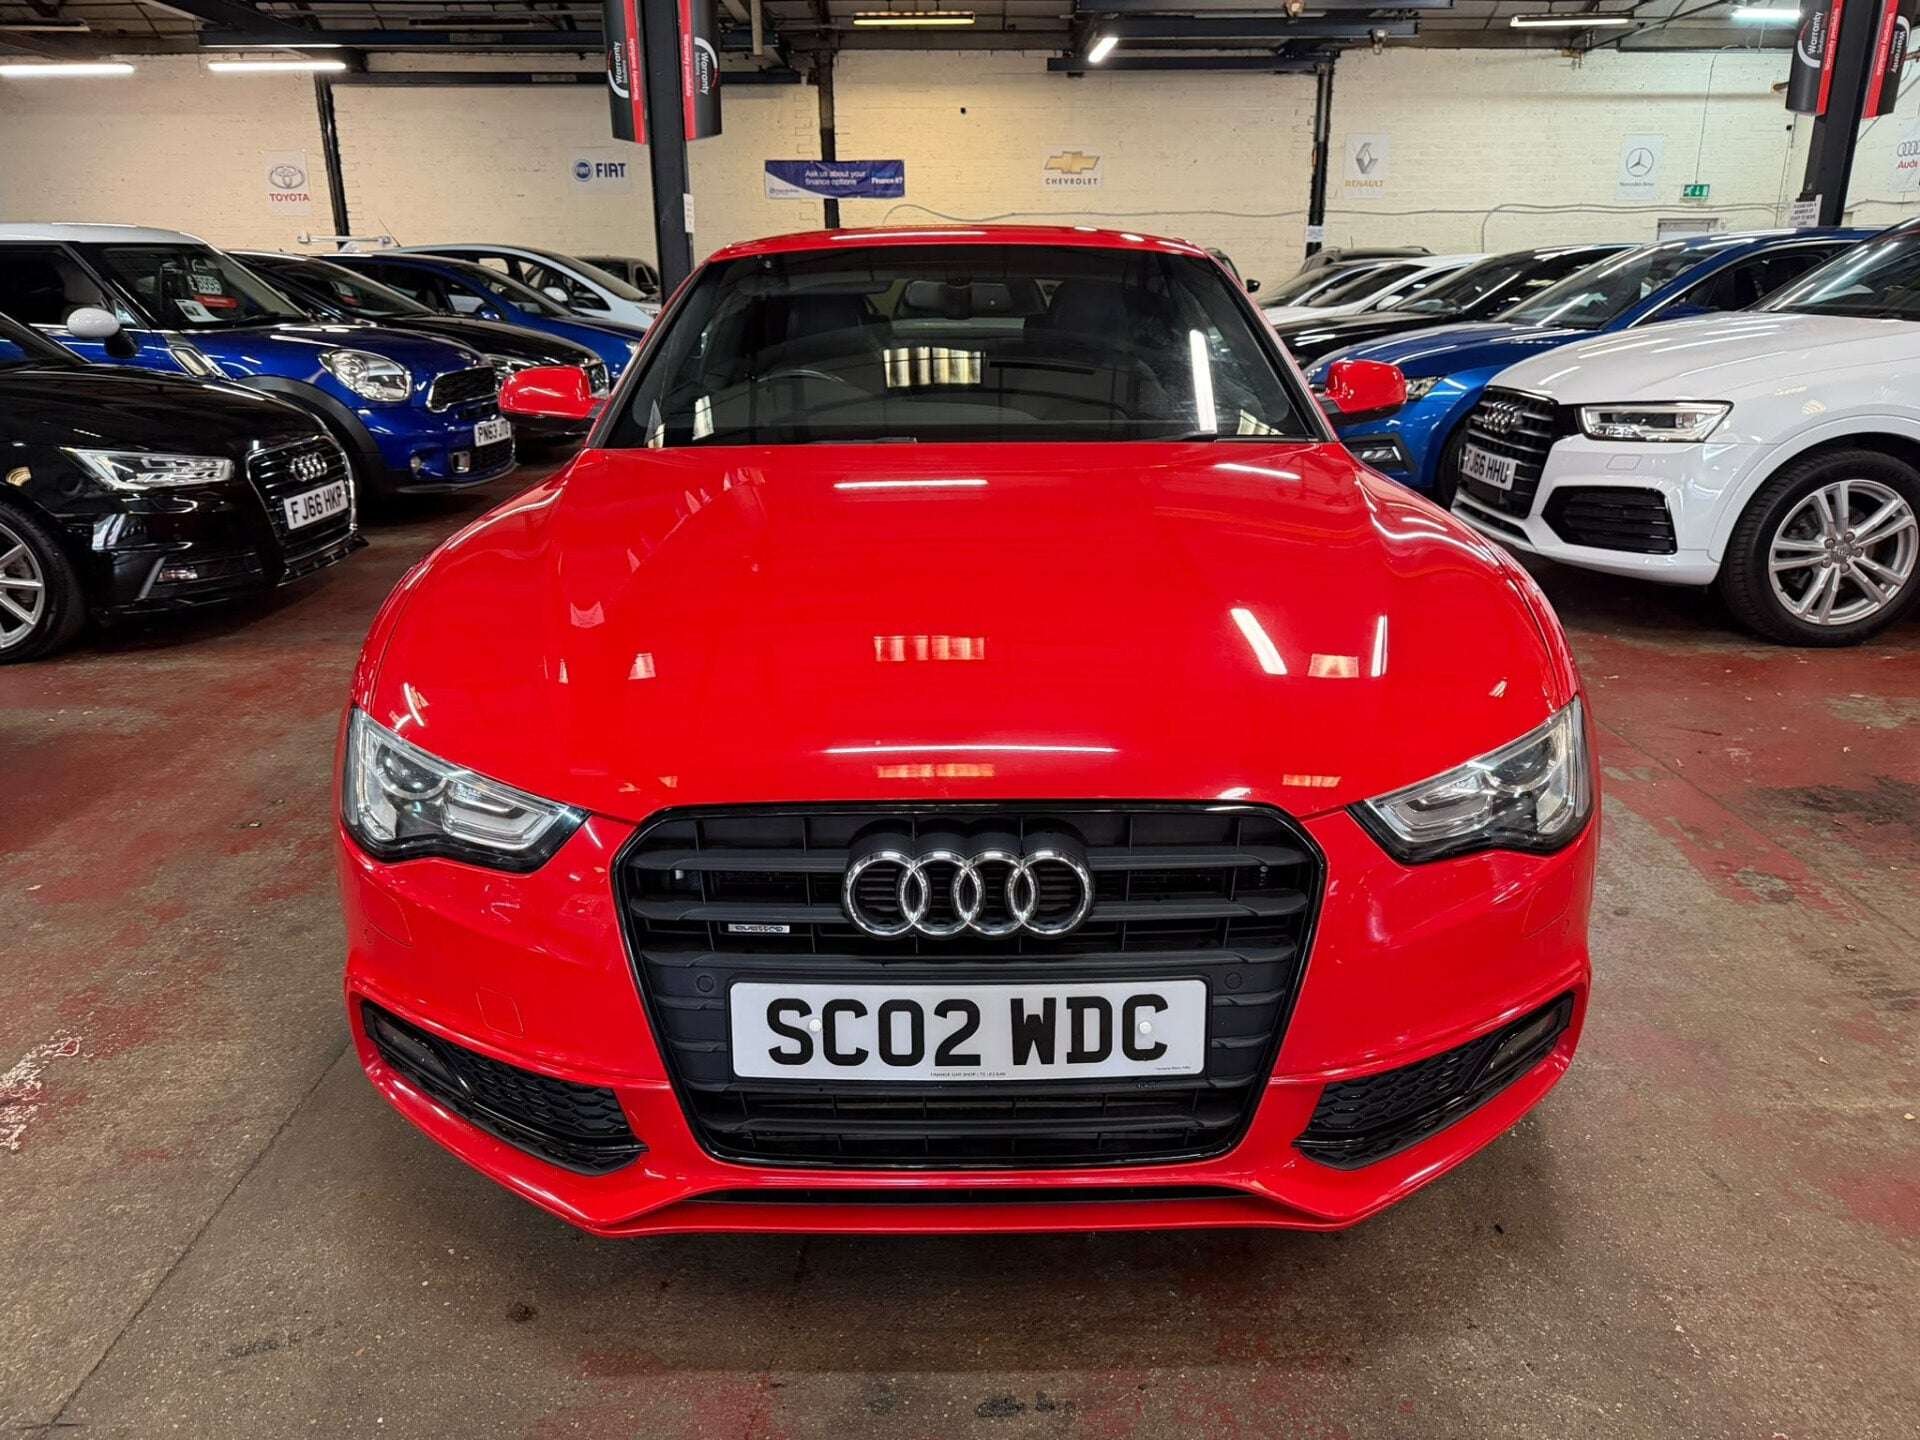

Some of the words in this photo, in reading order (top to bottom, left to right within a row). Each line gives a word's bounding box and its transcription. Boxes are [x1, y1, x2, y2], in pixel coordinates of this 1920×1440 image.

[1808, 12, 1824, 54] Warranty
[613, 41, 622, 84] Warranty
[1891, 31, 1906, 73] Warranty
[700, 52, 709, 95] Warranty
[595, 163, 626, 178] FIAT
[850, 170, 867, 179] your
[1897, 160, 1918, 169] Audi
[831, 178, 857, 186] options
[1045, 177, 1098, 185] CHEVROLET
[1344, 180, 1384, 188] RENAULT
[269, 193, 310, 202] TOYOTA
[1465, 449, 1485, 476] FJ66
[1486, 456, 1509, 484] HHU
[290, 494, 323, 524] FJ66
[323, 485, 342, 512] HKP
[766, 998, 981, 1067] SC02
[1010, 994, 1168, 1066] WDC
